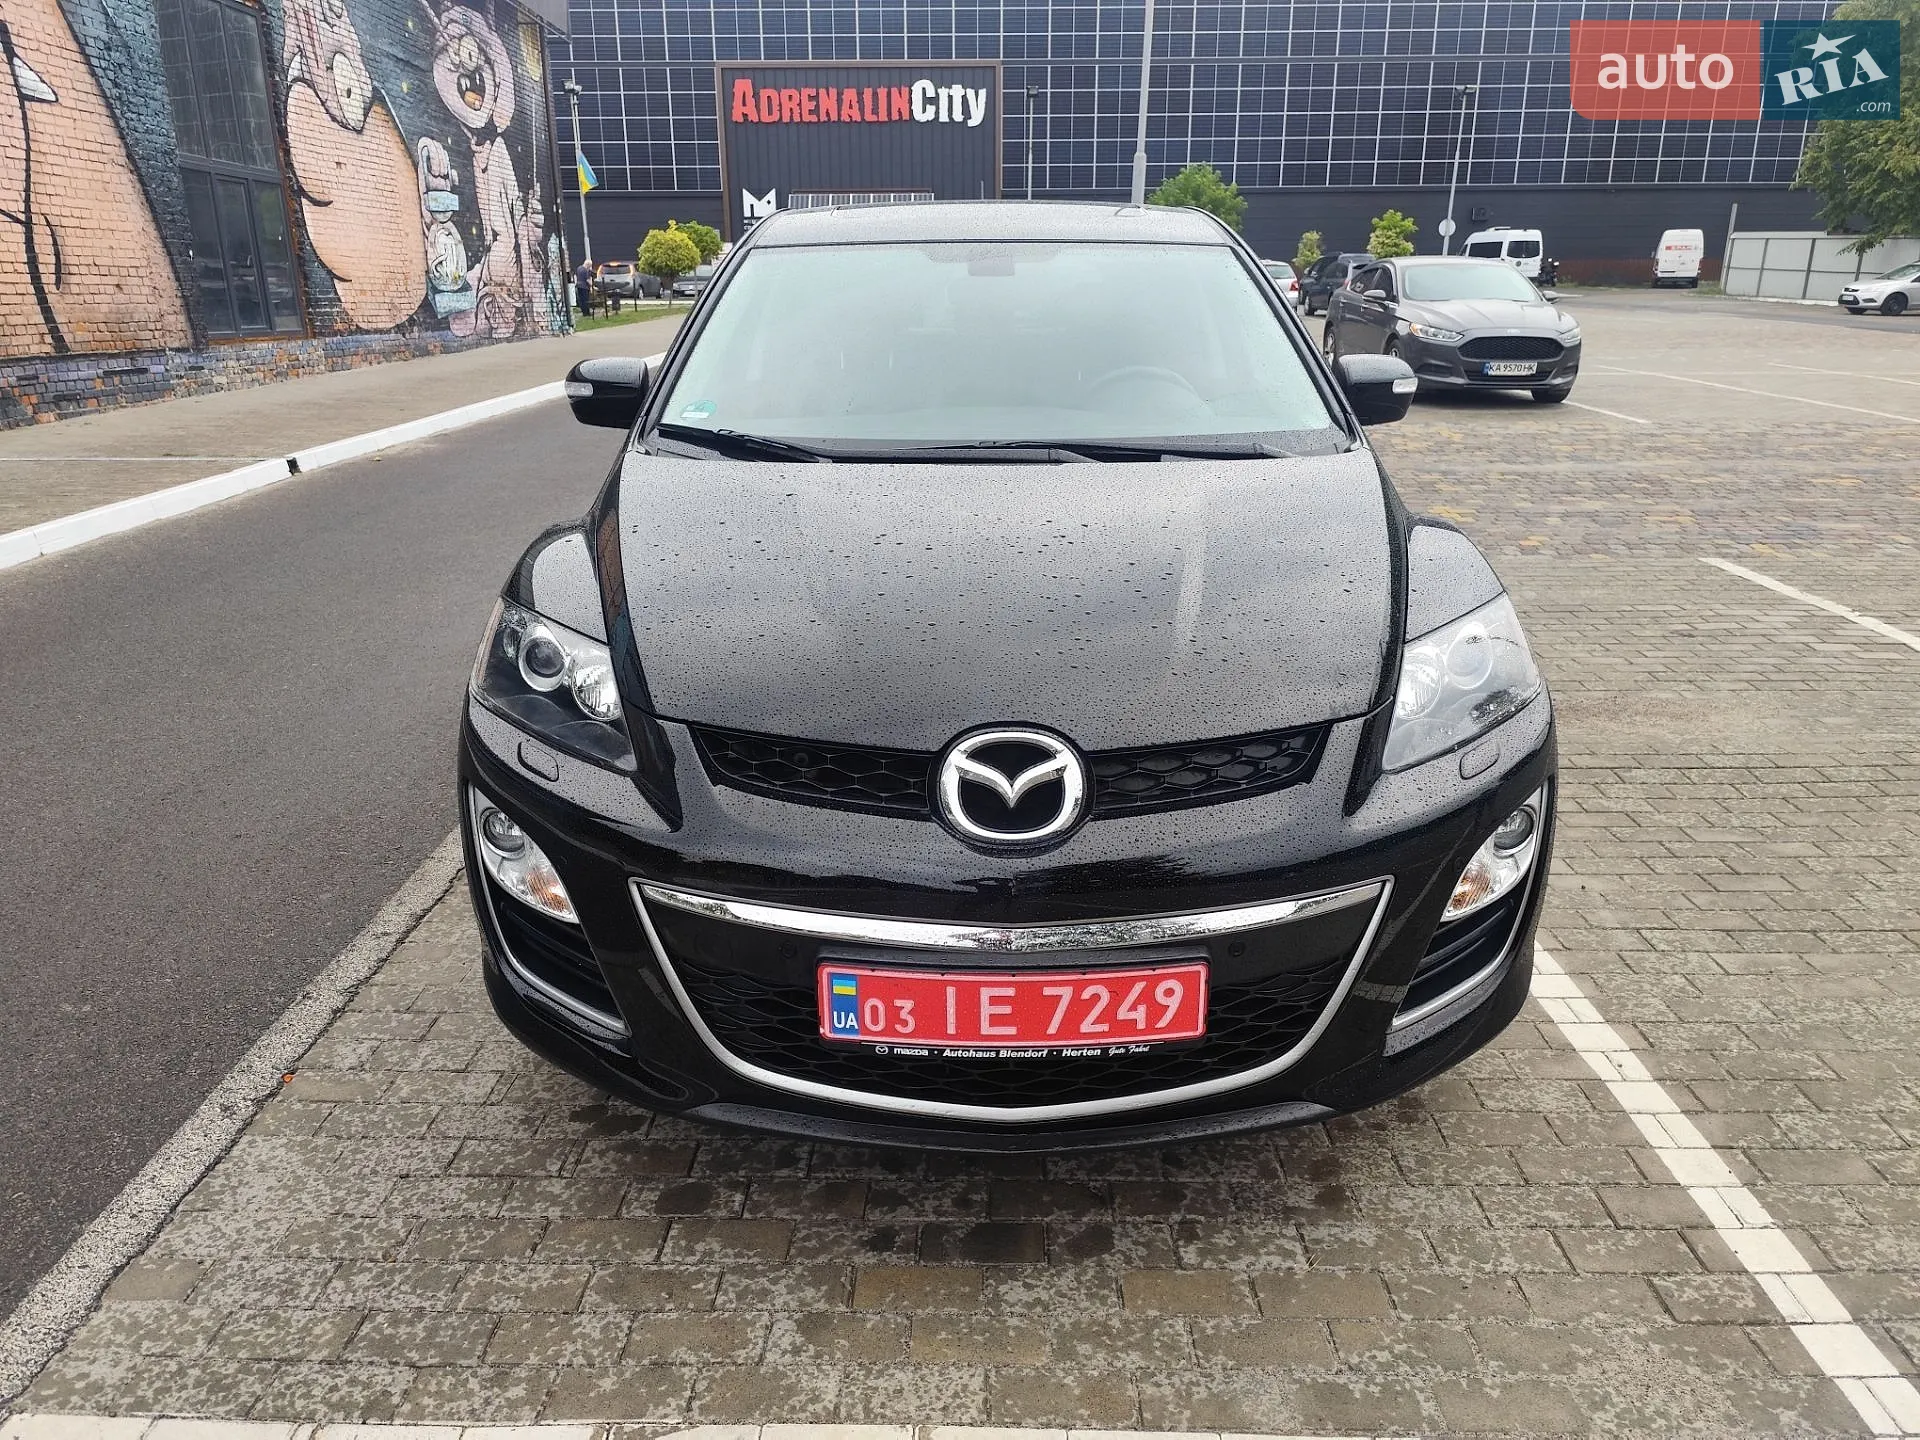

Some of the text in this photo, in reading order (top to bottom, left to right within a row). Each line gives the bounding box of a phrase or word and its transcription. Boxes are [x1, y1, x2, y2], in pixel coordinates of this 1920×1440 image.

[1488, 363, 1501, 372] KA
[1503, 363, 1523, 372] 9570
[863, 978, 1185, 1035] 03 IE 7249
[832, 1011, 859, 1029] UA
[893, 1047, 929, 1056] mazda
[942, 1048, 997, 1058] Autohaus
[1062, 1048, 1101, 1057] Herten
